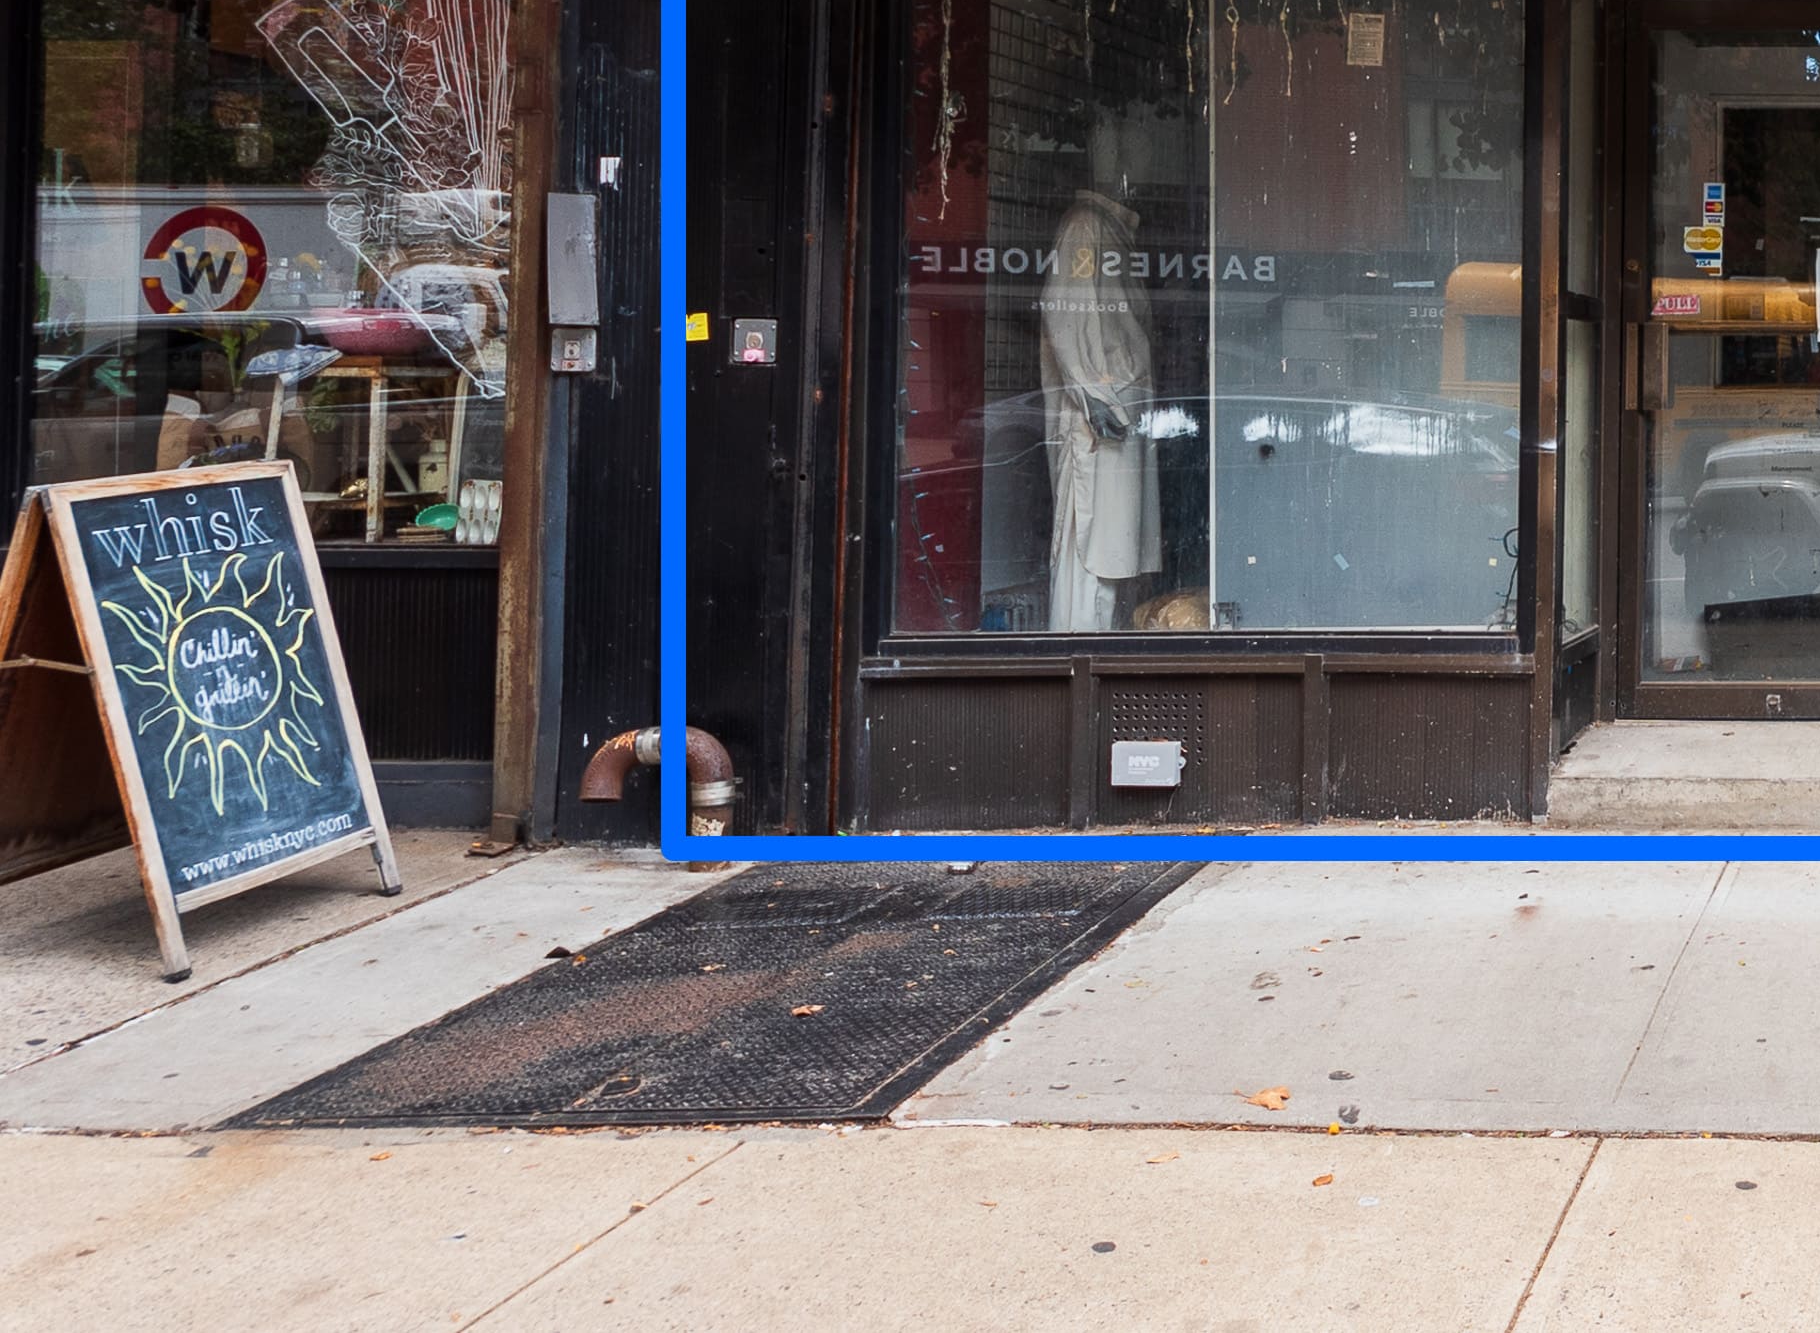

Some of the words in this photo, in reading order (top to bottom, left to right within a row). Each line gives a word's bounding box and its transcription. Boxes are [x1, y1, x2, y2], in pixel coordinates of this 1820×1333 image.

[175, 251, 236, 295] W
[1658, 296, 1698, 311] PULL
[92, 487, 274, 567] whisk
[180, 628, 258, 669] Chillin'
[1128, 755, 1160, 767] NYC
[181, 813, 353, 882] www.whisknyc.com
